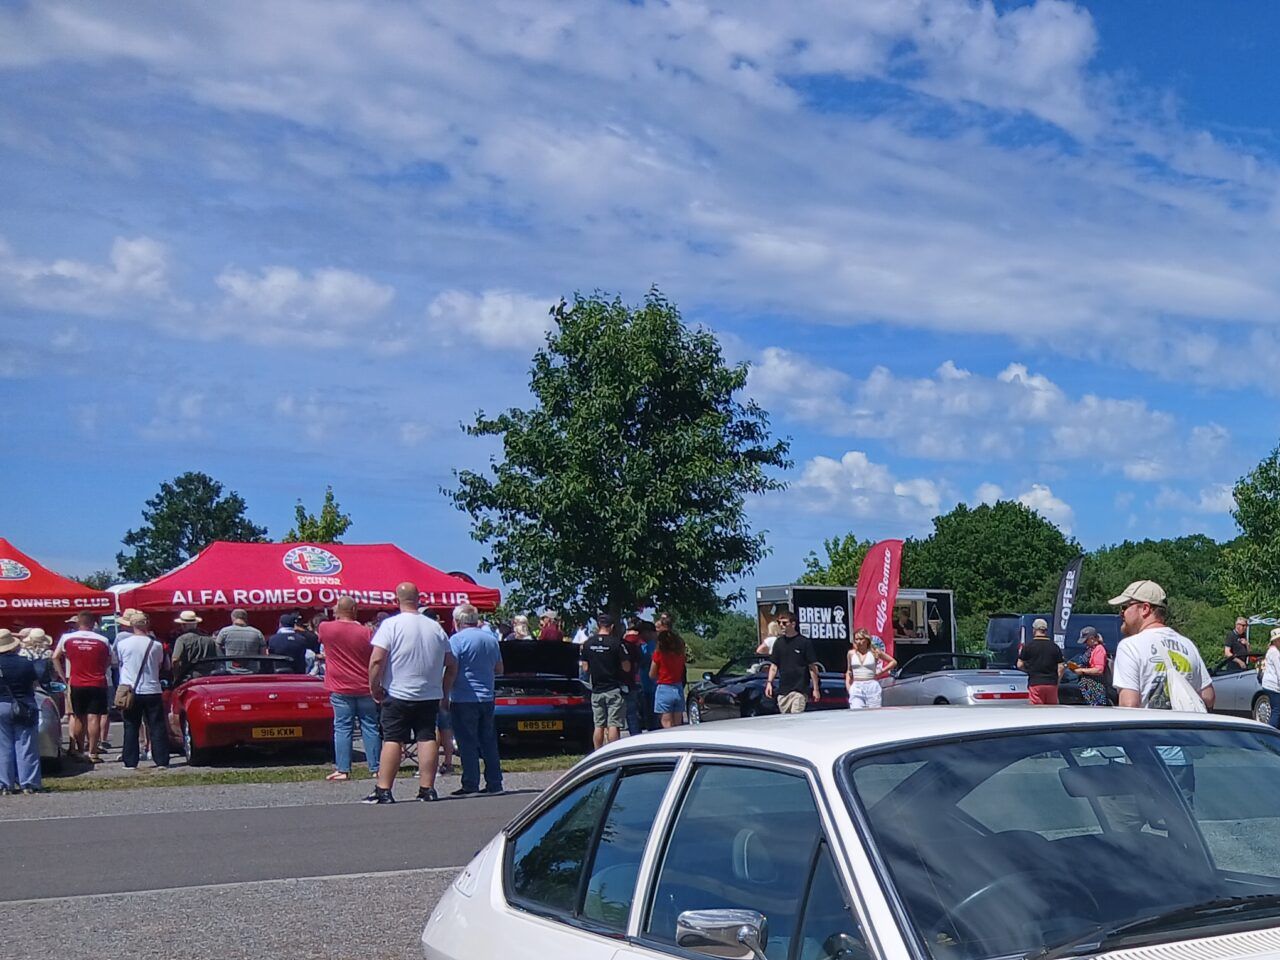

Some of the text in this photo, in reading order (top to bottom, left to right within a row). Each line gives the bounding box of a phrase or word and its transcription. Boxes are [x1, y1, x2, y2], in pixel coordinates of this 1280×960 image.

[11, 598, 70, 608] OWNERS
[74, 597, 110, 607] CLUB
[172, 589, 229, 605] ALFA
[233, 588, 313, 605] ROMEO
[318, 588, 398, 605] OWNER
[1060, 569, 1076, 631] COFFEE
[799, 606, 832, 623] BREW
[811, 623, 847, 639] BEATS
